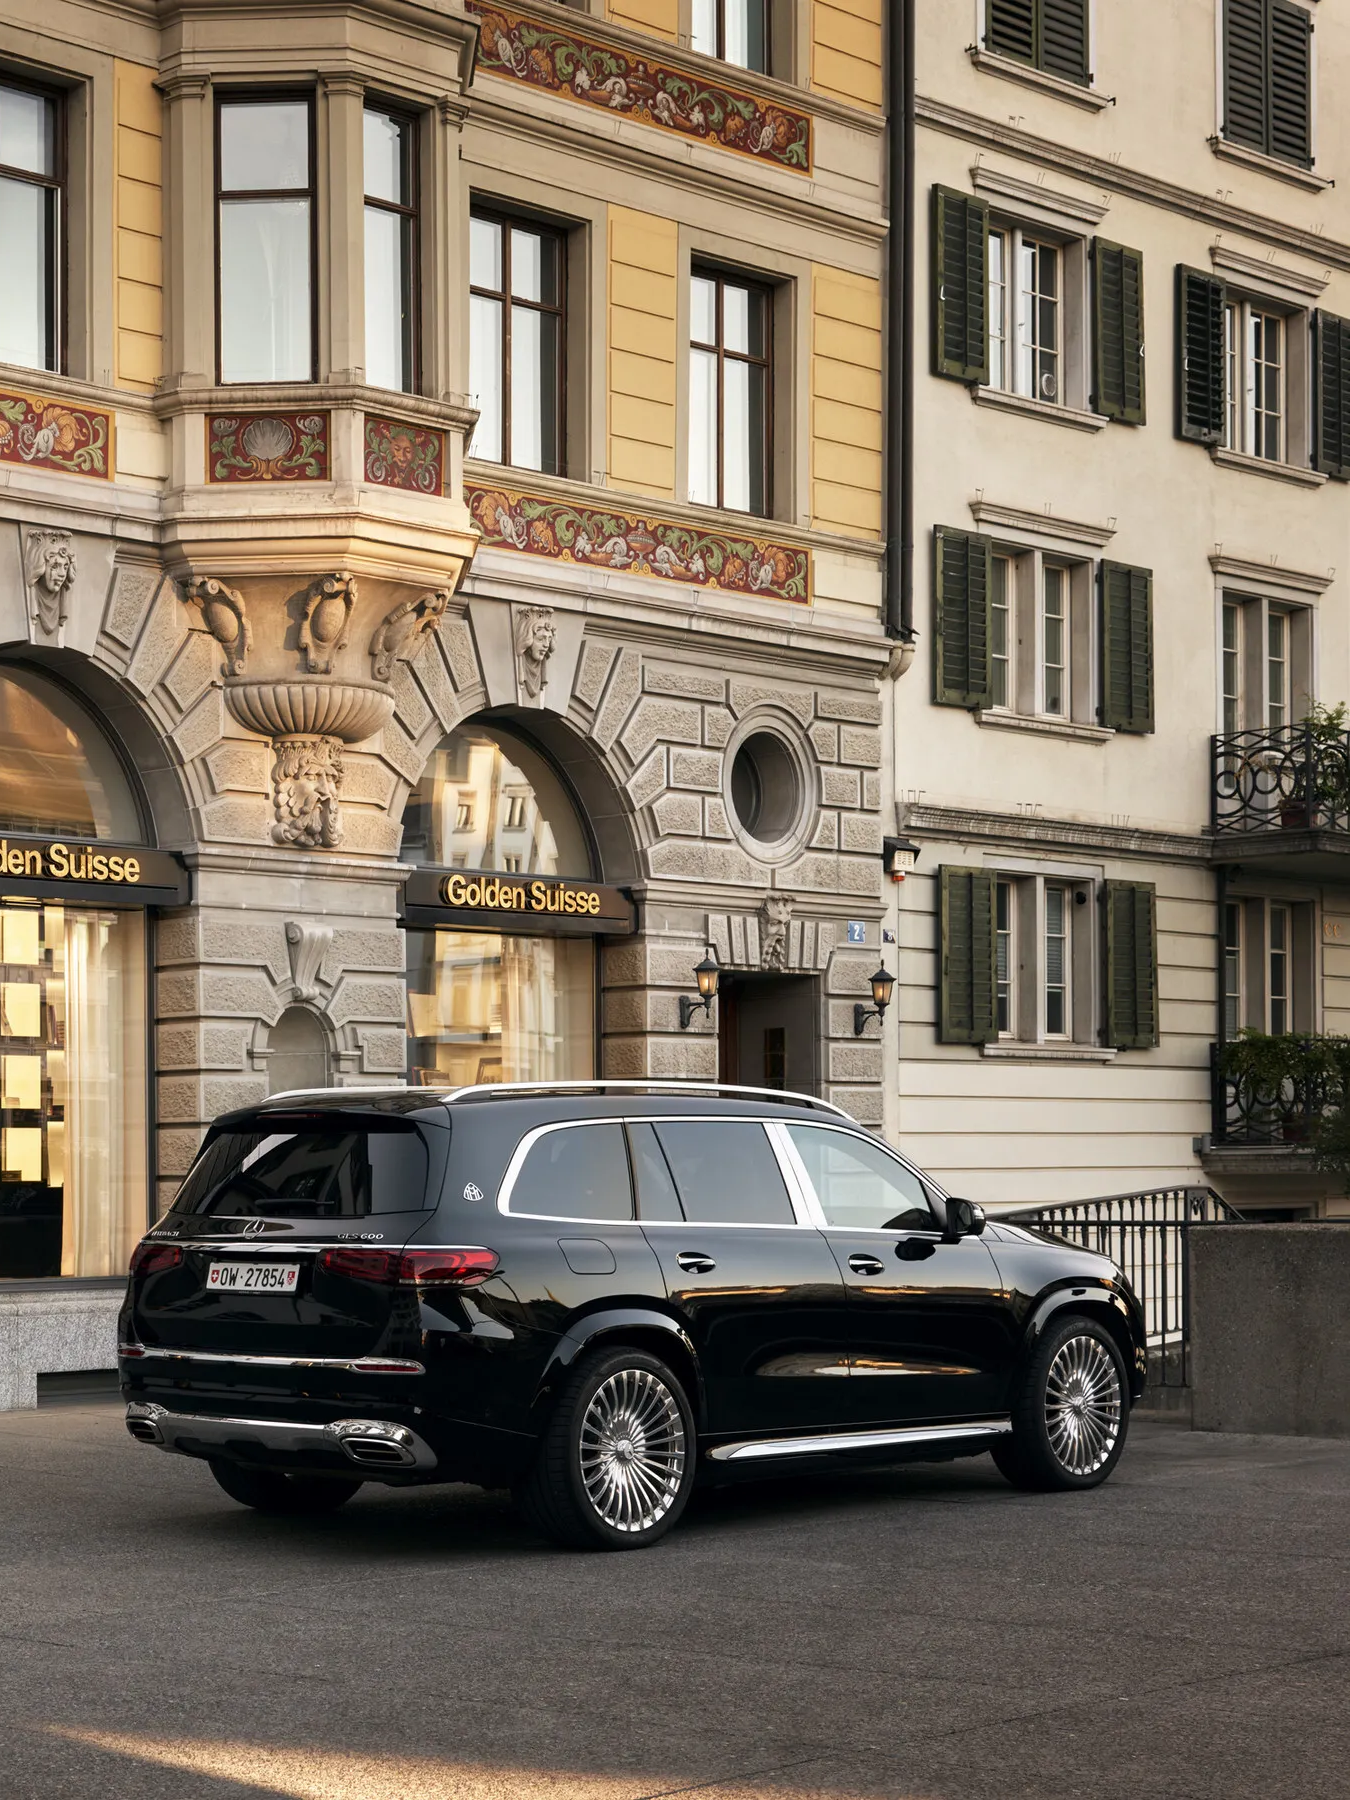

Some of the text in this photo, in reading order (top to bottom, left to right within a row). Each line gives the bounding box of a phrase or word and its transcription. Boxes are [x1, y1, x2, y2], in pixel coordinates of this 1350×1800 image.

[50, 843, 140, 883] Suisse
[447, 874, 600, 914] Golden Suisse
[853, 924, 860, 940] 2
[337, 1232, 359, 1240] GLS
